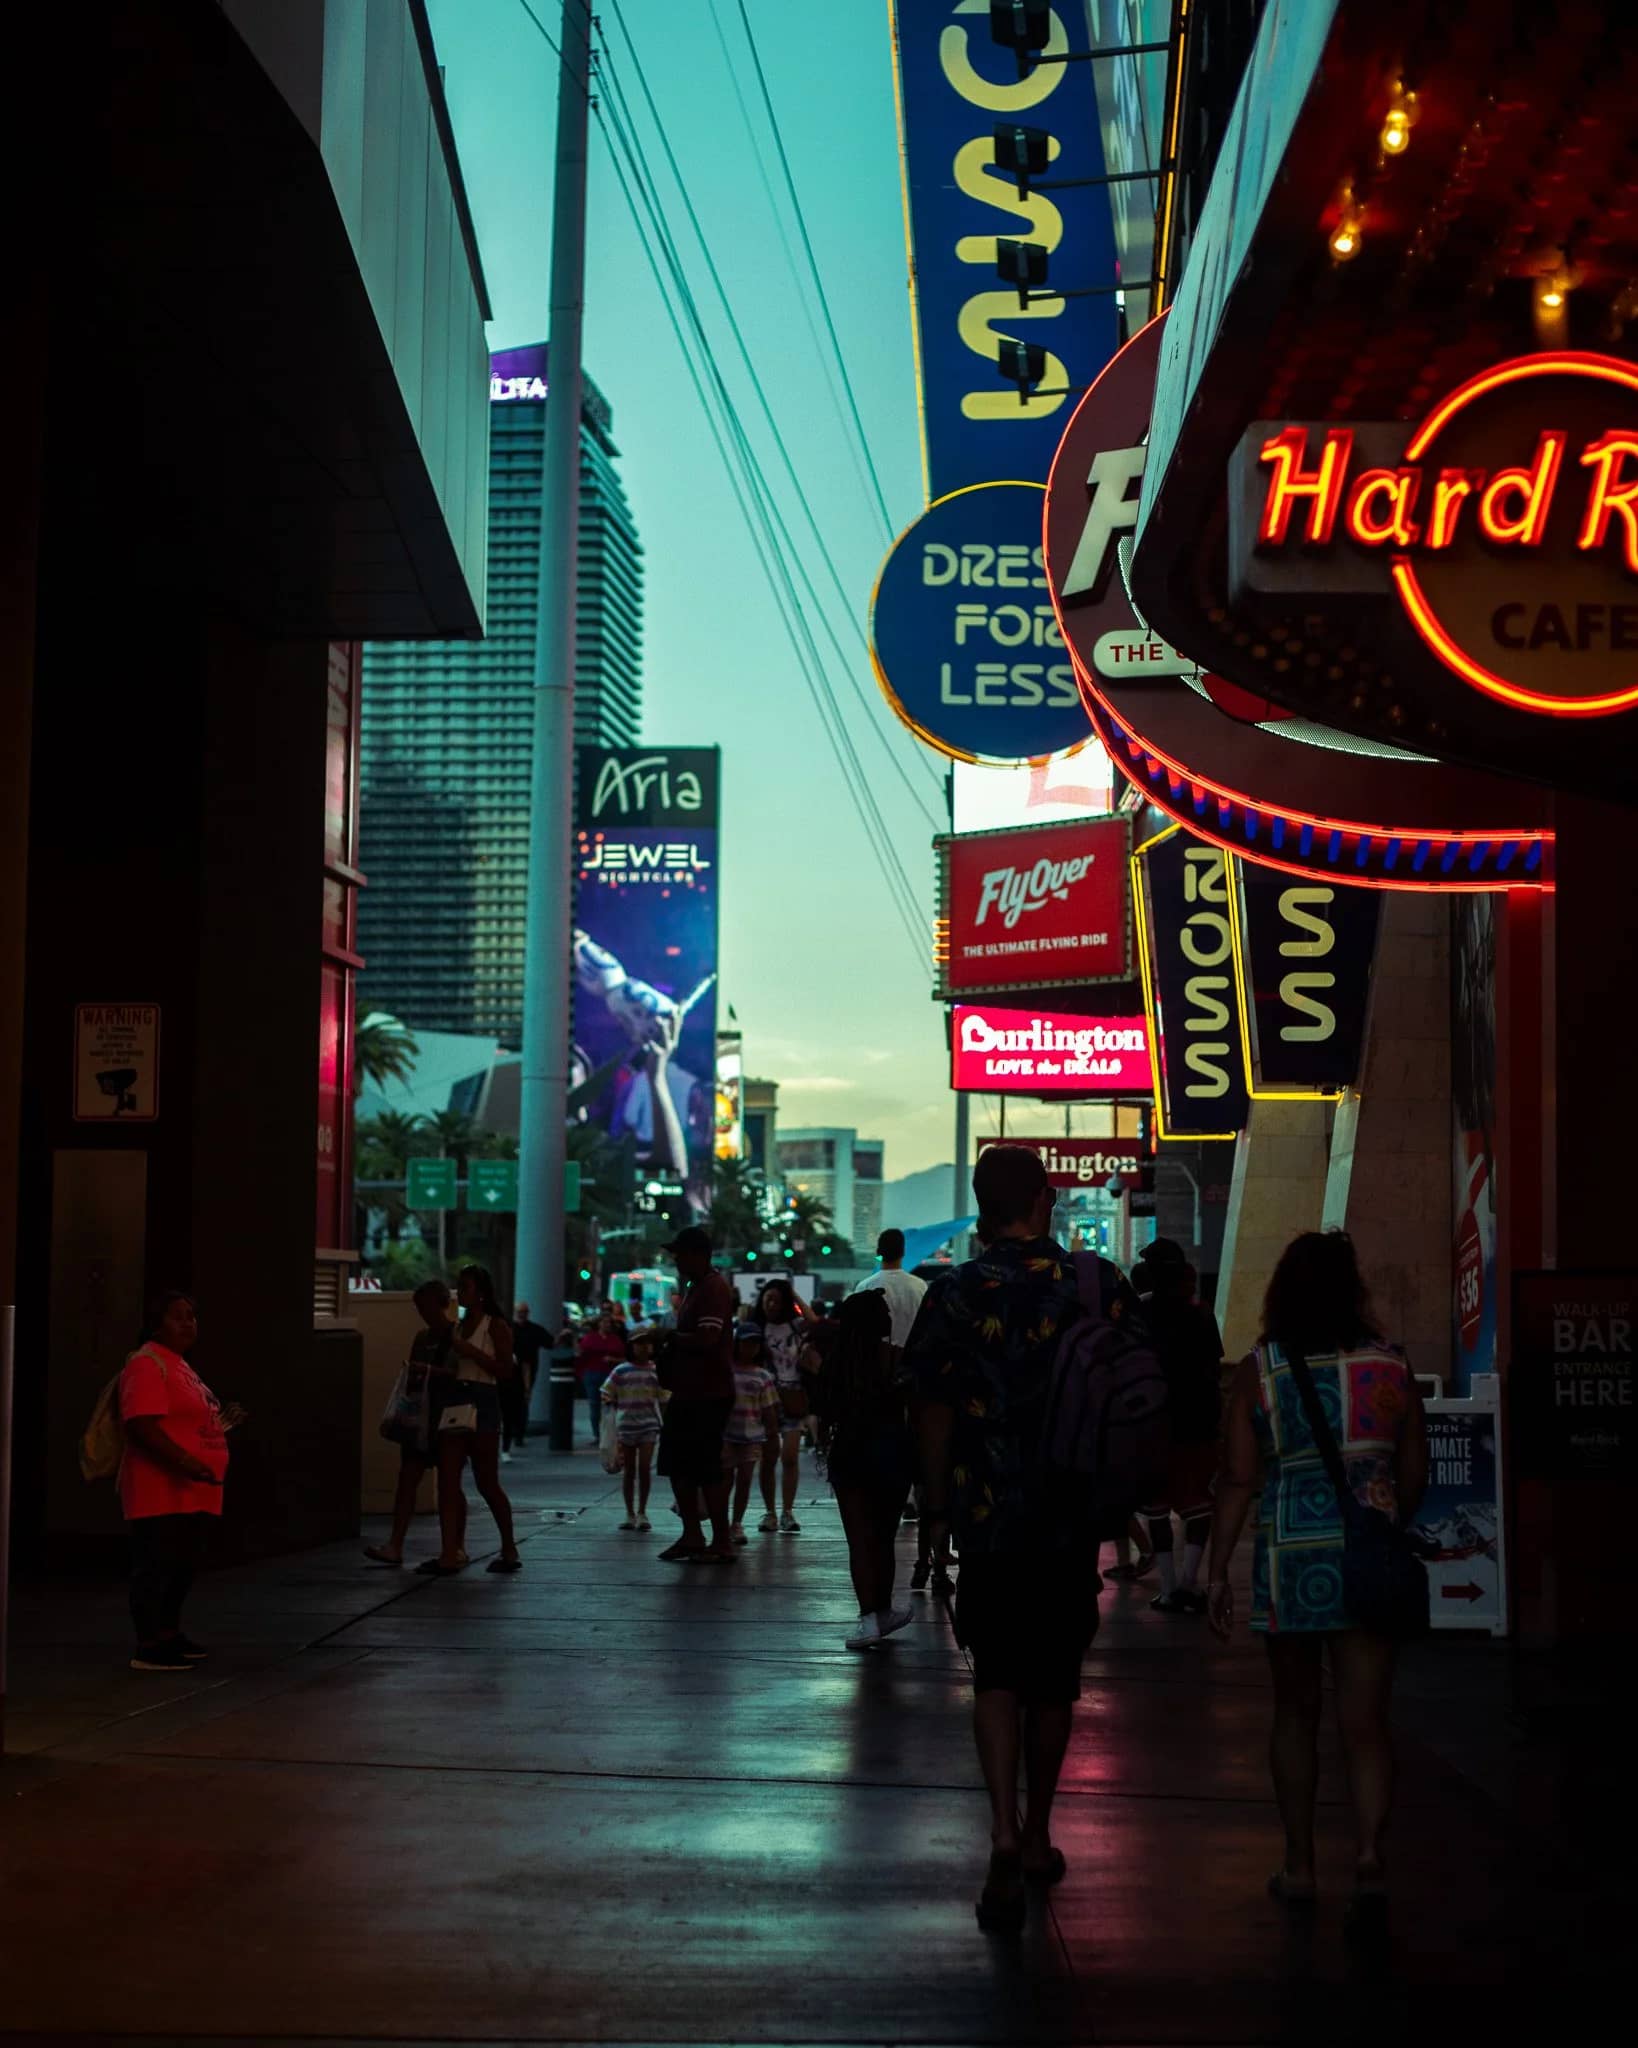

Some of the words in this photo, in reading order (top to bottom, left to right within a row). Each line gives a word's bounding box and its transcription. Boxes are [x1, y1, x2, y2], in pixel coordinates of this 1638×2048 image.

[1259, 427, 1567, 549] Hard
[955, 604, 1071, 647] FOR
[1491, 602, 1638, 651] CAFE
[1110, 643, 1164, 663] THE
[941, 663, 1081, 707] LESS
[592, 756, 701, 817] Aria
[582, 844, 710, 868] JEWEL
[974, 854, 1095, 928] FlyOver
[963, 946, 984, 957] THE
[986, 940, 1037, 956] ULTIMATE
[1039, 935, 1078, 950] FLYING
[1080, 933, 1108, 946] RIDE
[1180, 848, 1232, 1098] ROSS
[83, 1008, 153, 1025] WARNING
[961, 1015, 1146, 1059] Burlington
[986, 1059, 1034, 1075] LOVE
[1064, 1058, 1122, 1075] DEALS
[979, 1143, 1138, 1181] lington
[1552, 1302, 1631, 1317] WALK-UP
[1552, 1319, 1633, 1352] BAR
[1552, 1360, 1633, 1376] ENTRANCE
[1554, 1378, 1633, 1407] HERE
[1437, 1461, 1472, 1486] RIDE
